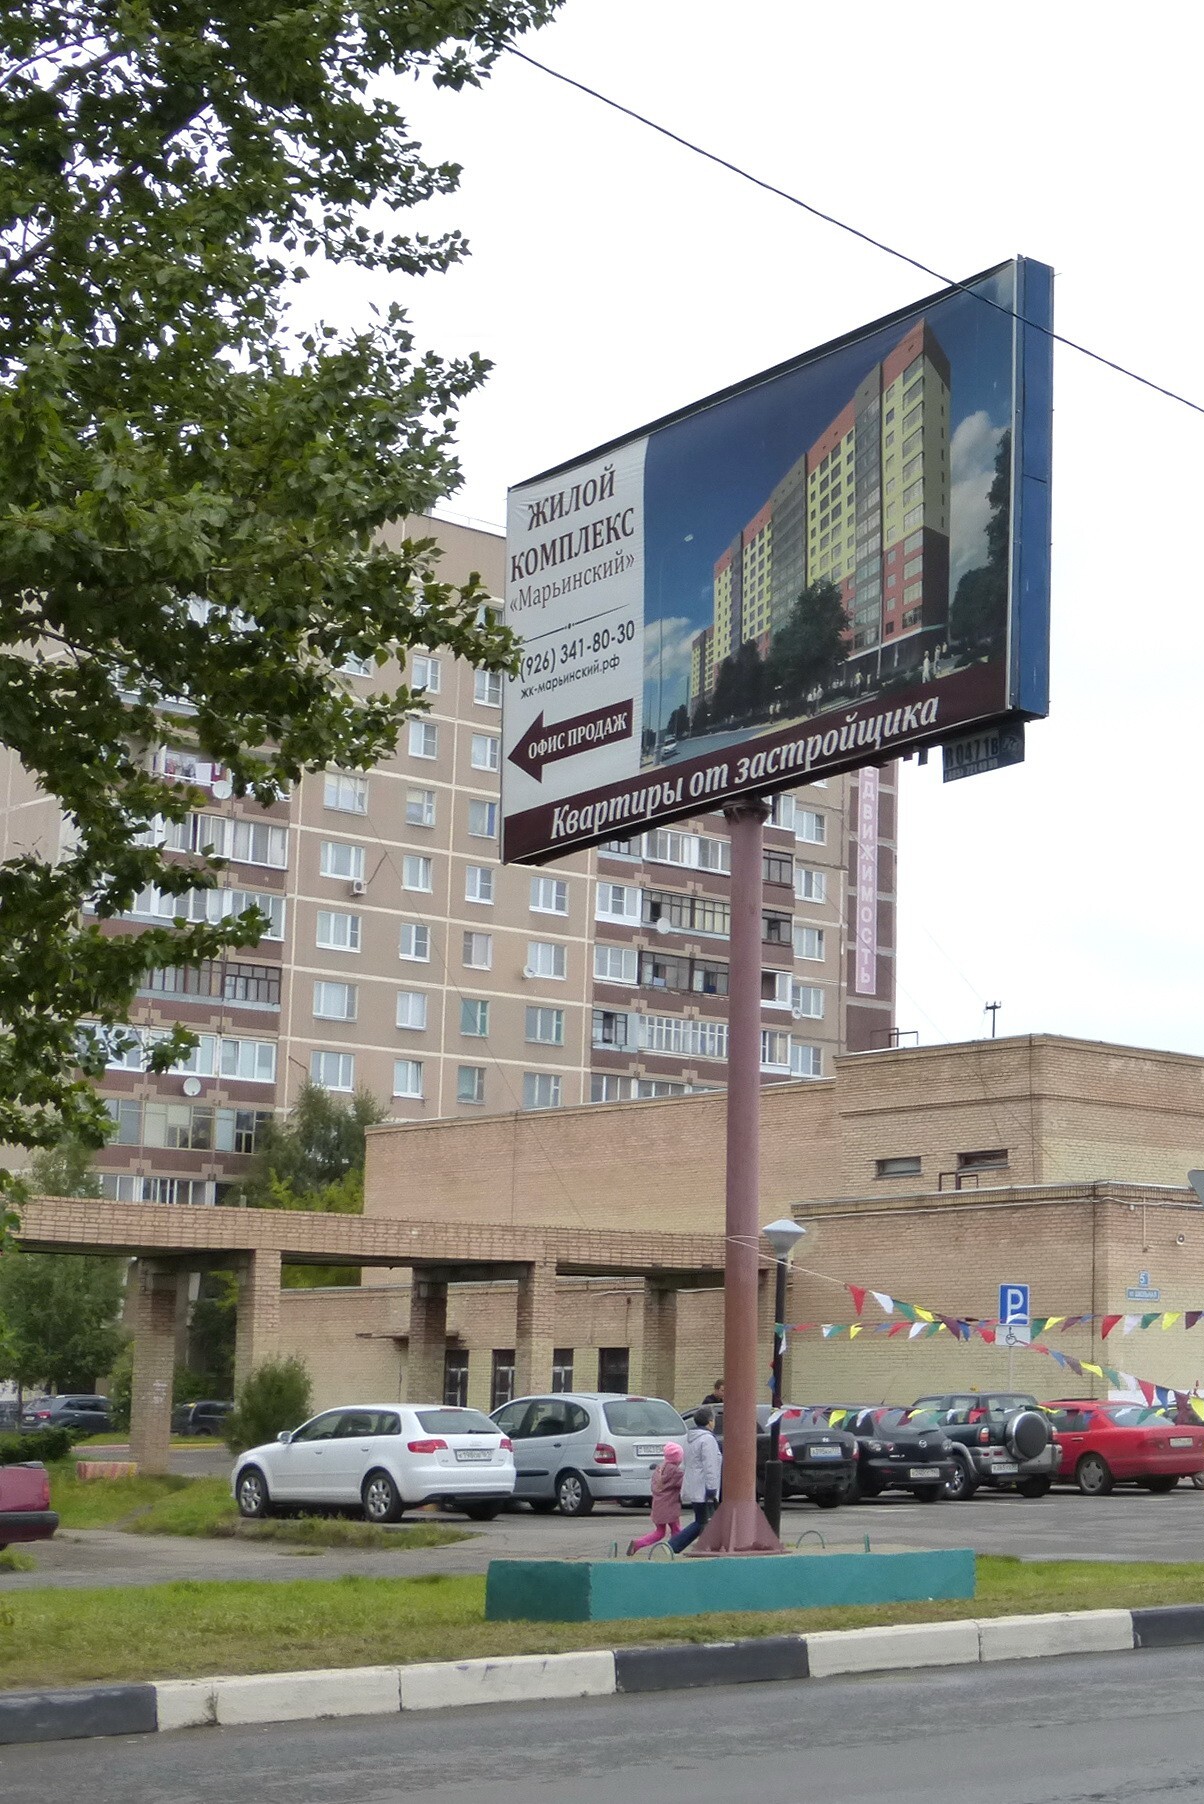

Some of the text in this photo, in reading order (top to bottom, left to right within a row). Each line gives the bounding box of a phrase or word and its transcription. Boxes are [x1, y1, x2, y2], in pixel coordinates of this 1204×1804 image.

[527, 463, 616, 532] ЖИЛОЙ
[510, 507, 634, 583] КОМПЛЕКС
[509, 549, 635, 612] «Марьинский»
[520, 620, 635, 684] (926) 341-80-30
[520, 653, 621, 700] жк-марьинский.рф
[527, 712, 628, 760] ОФИС ПРОДАЖ
[550, 695, 940, 841] Квартиры от застройщика
[1007, 1288, 1024, 1317] P
